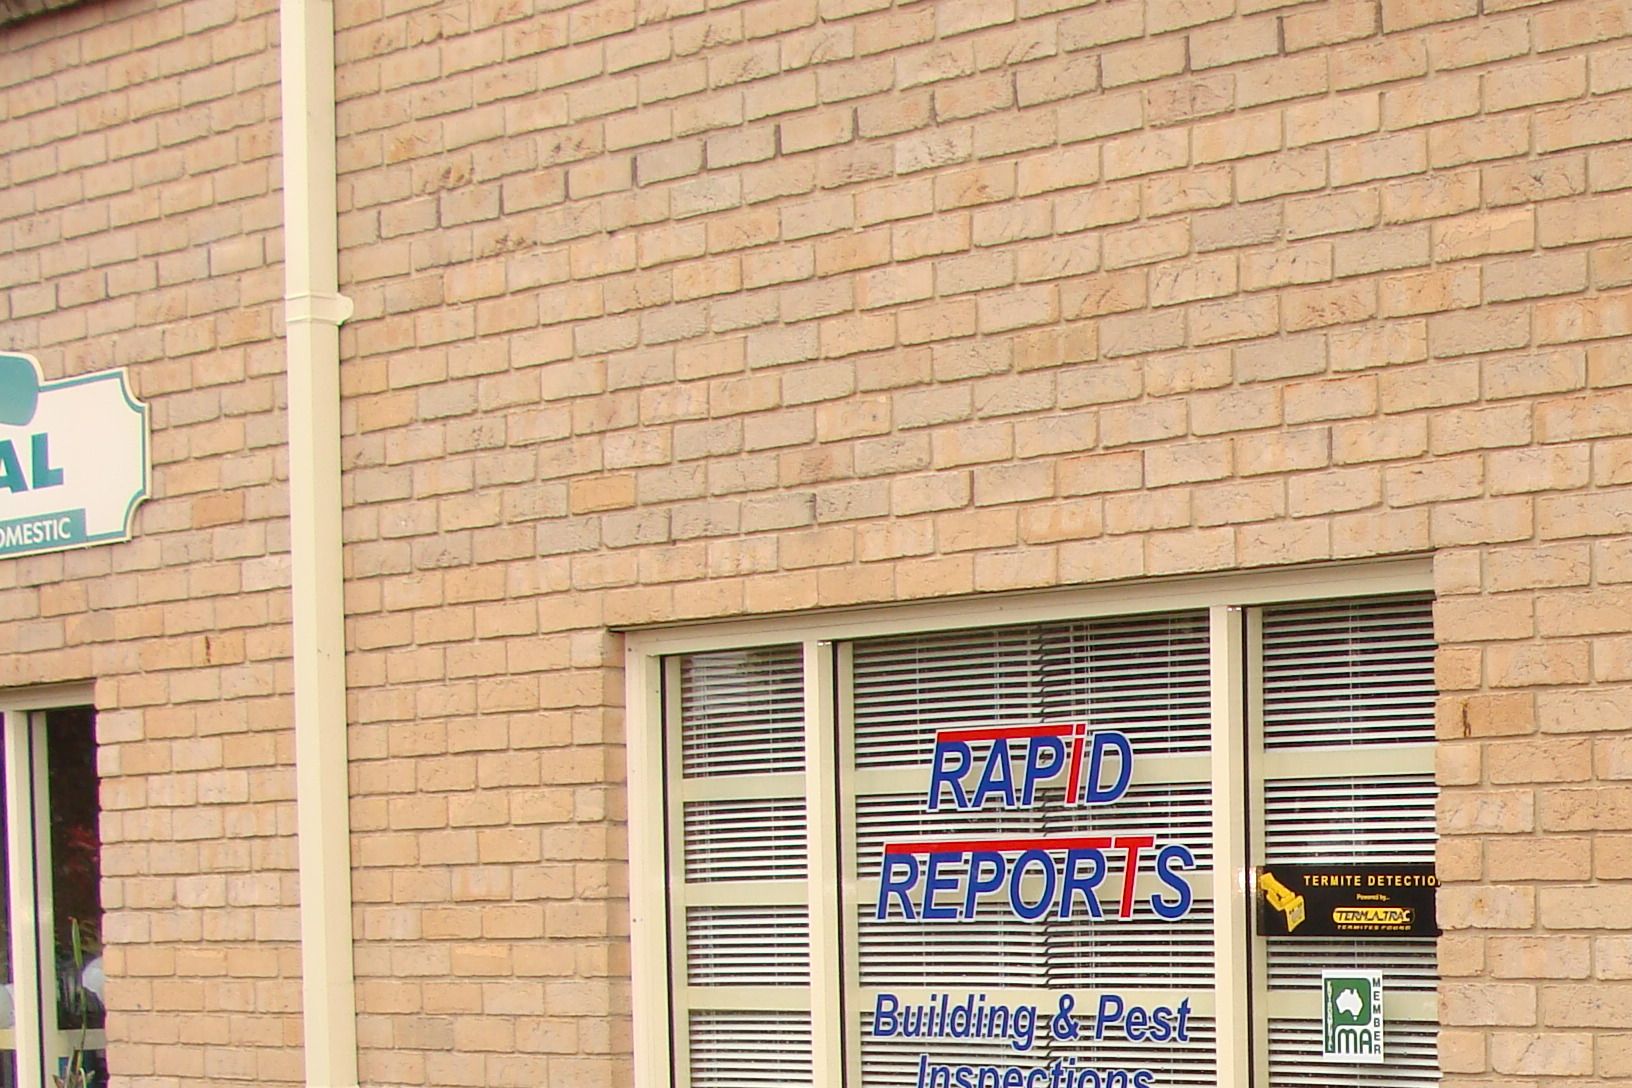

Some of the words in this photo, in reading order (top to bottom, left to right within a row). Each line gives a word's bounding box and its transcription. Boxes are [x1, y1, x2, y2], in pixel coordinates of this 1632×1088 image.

[875, 834, 1196, 923] REPORTS
[1303, 874, 1362, 887] TERMITE
[1367, 874, 1441, 888] DETECTIO
[1356, 893, 1379, 901] Powered
[873, 993, 1038, 1052] Building
[1052, 993, 1079, 1042] &
[1095, 994, 1192, 1043] Pest
[1372, 977, 1382, 1054] MEMBER
